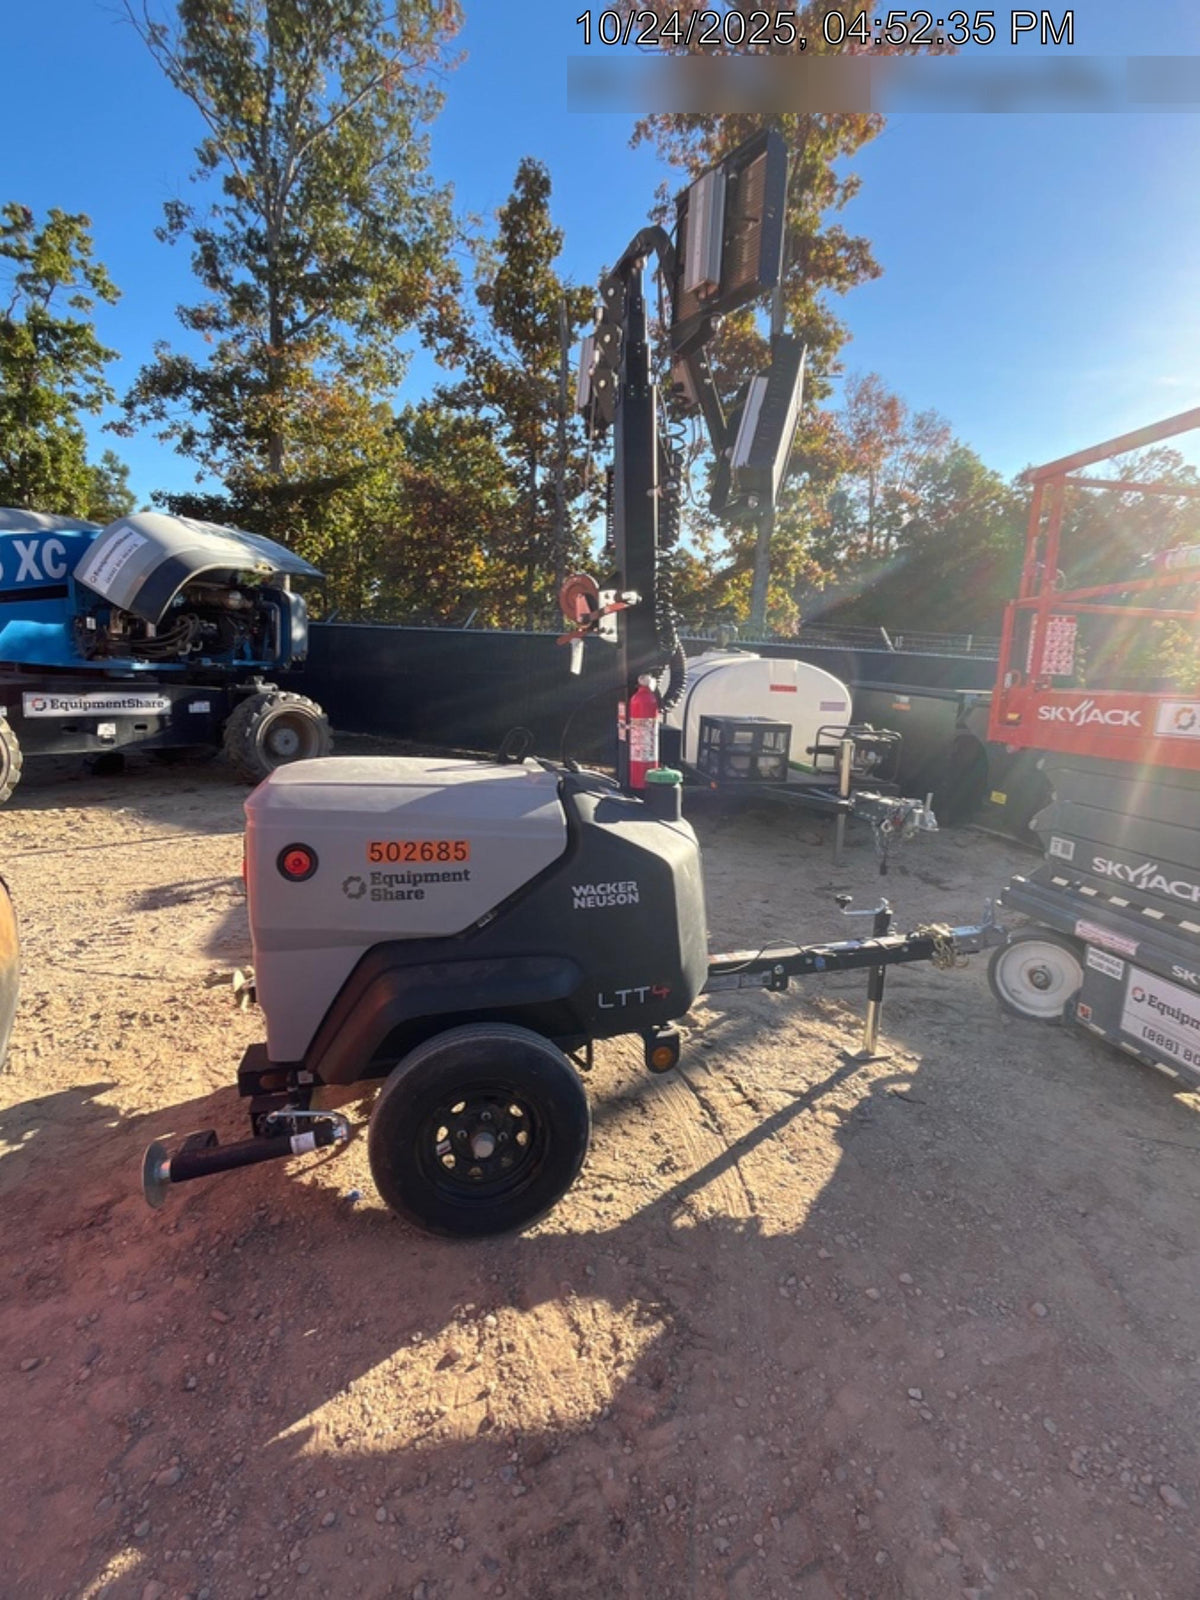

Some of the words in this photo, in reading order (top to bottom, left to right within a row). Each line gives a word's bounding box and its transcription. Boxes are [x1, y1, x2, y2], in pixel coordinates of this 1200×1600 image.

[11, 538, 67, 582] XC
[49, 697, 164, 712] EquipmentShare
[1037, 698, 1142, 727] SKYJACK
[369, 841, 467, 863] 502685
[370, 869, 471, 887] Equipment
[370, 888, 425, 902] Share
[571, 881, 639, 896] WACKER
[573, 892, 640, 909] NEUSON
[598, 985, 671, 1009] LTT4
